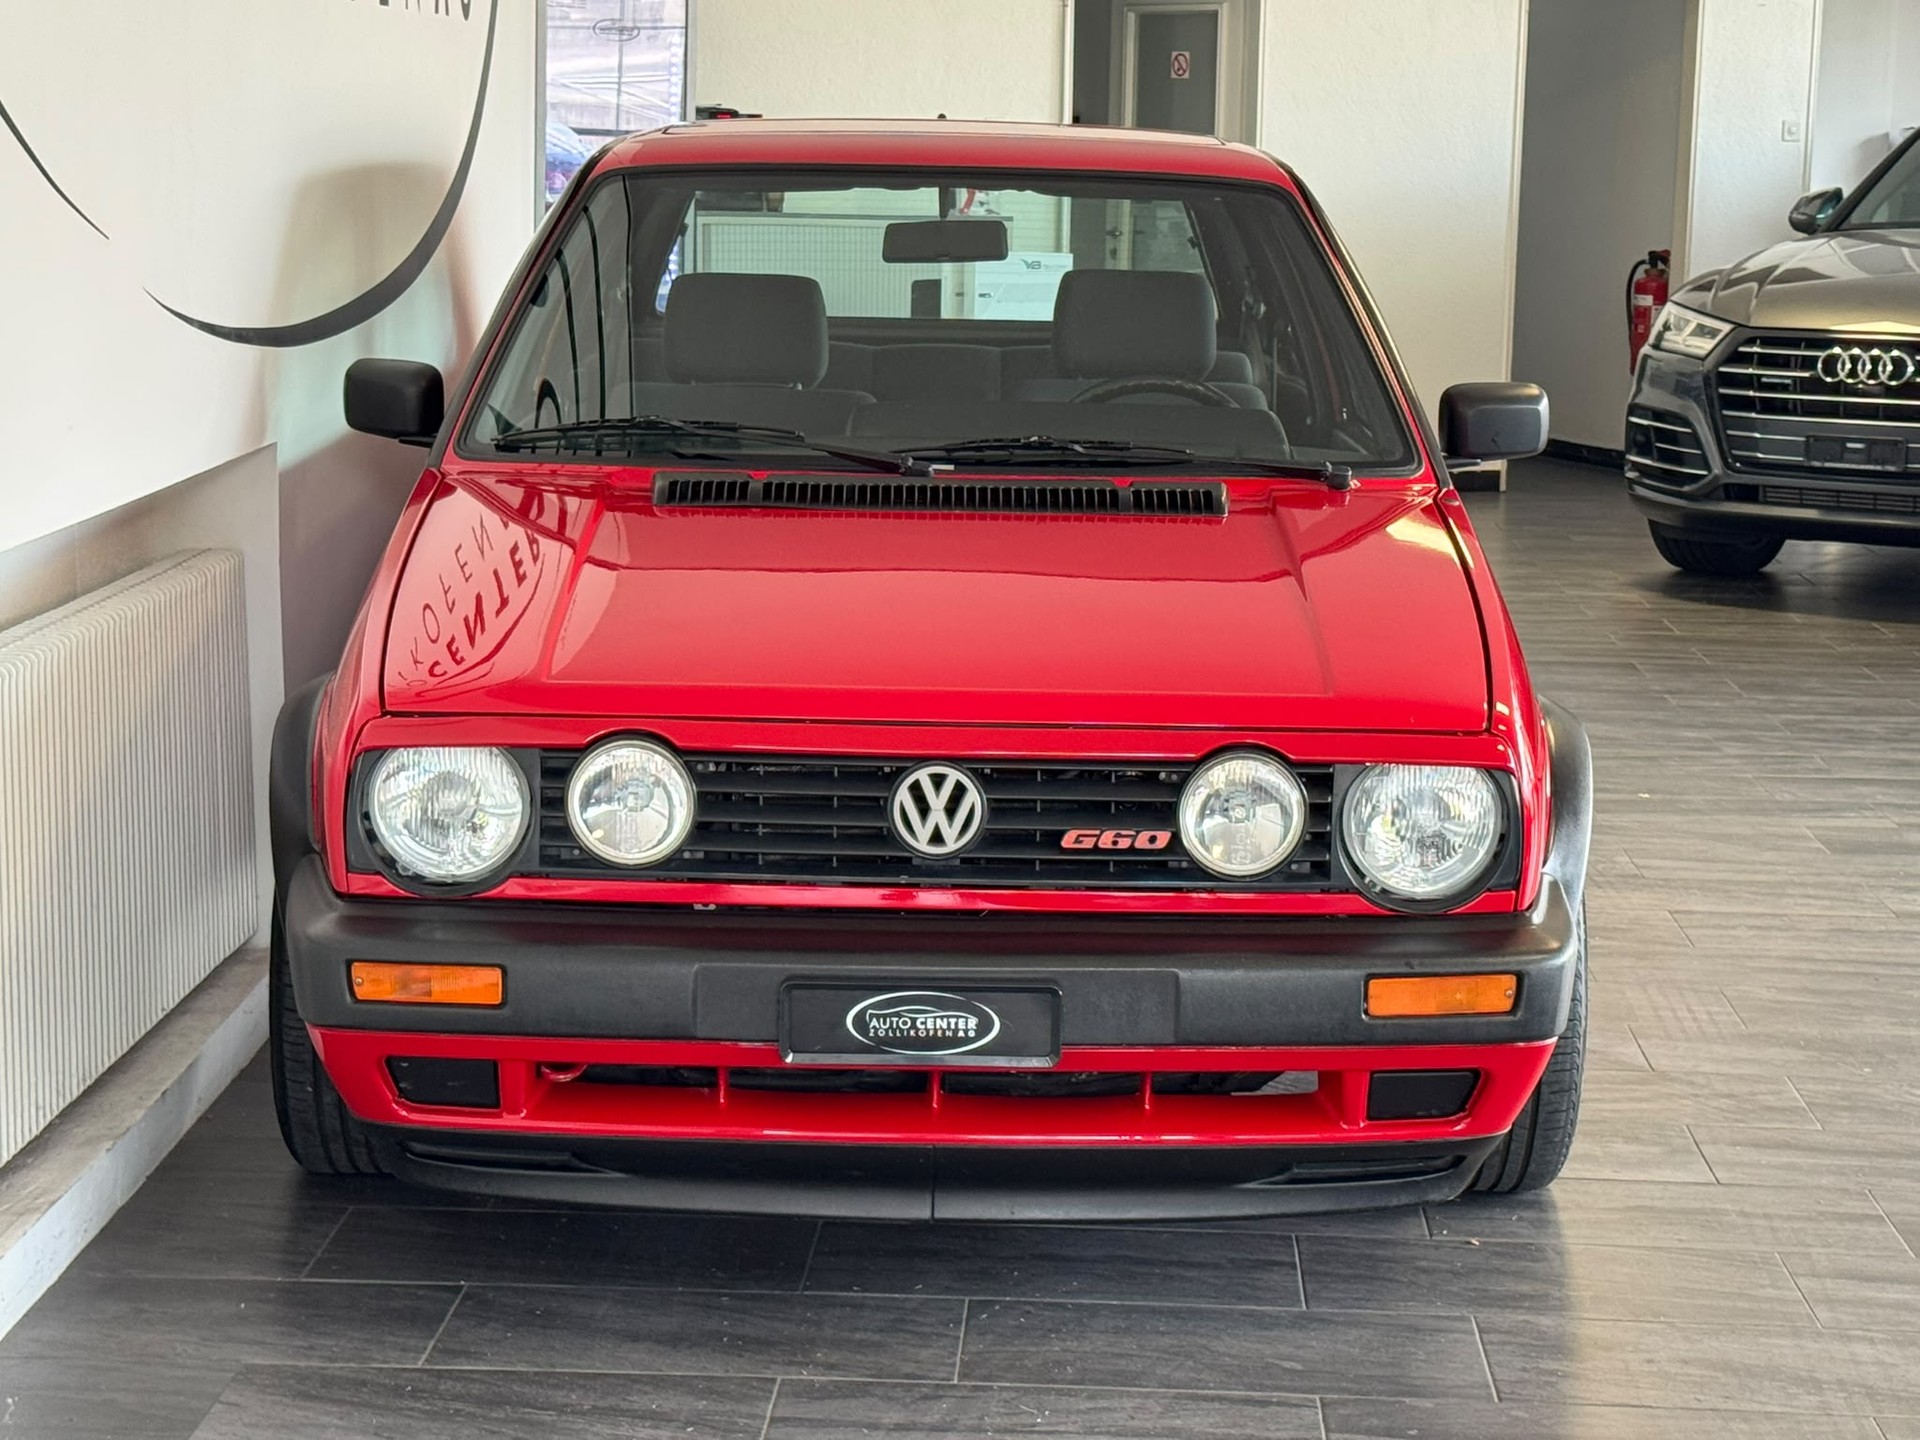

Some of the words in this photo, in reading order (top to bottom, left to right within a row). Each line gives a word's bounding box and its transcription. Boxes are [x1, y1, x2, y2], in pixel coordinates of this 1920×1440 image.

[892, 765, 983, 854] VW
[1060, 829, 1172, 850] G60
[869, 1017, 911, 1029] AUTO
[916, 1017, 978, 1030] CENTER
[868, 1029, 953, 1037] ZOLLIKOFEN
[957, 1030, 976, 1038] AG
